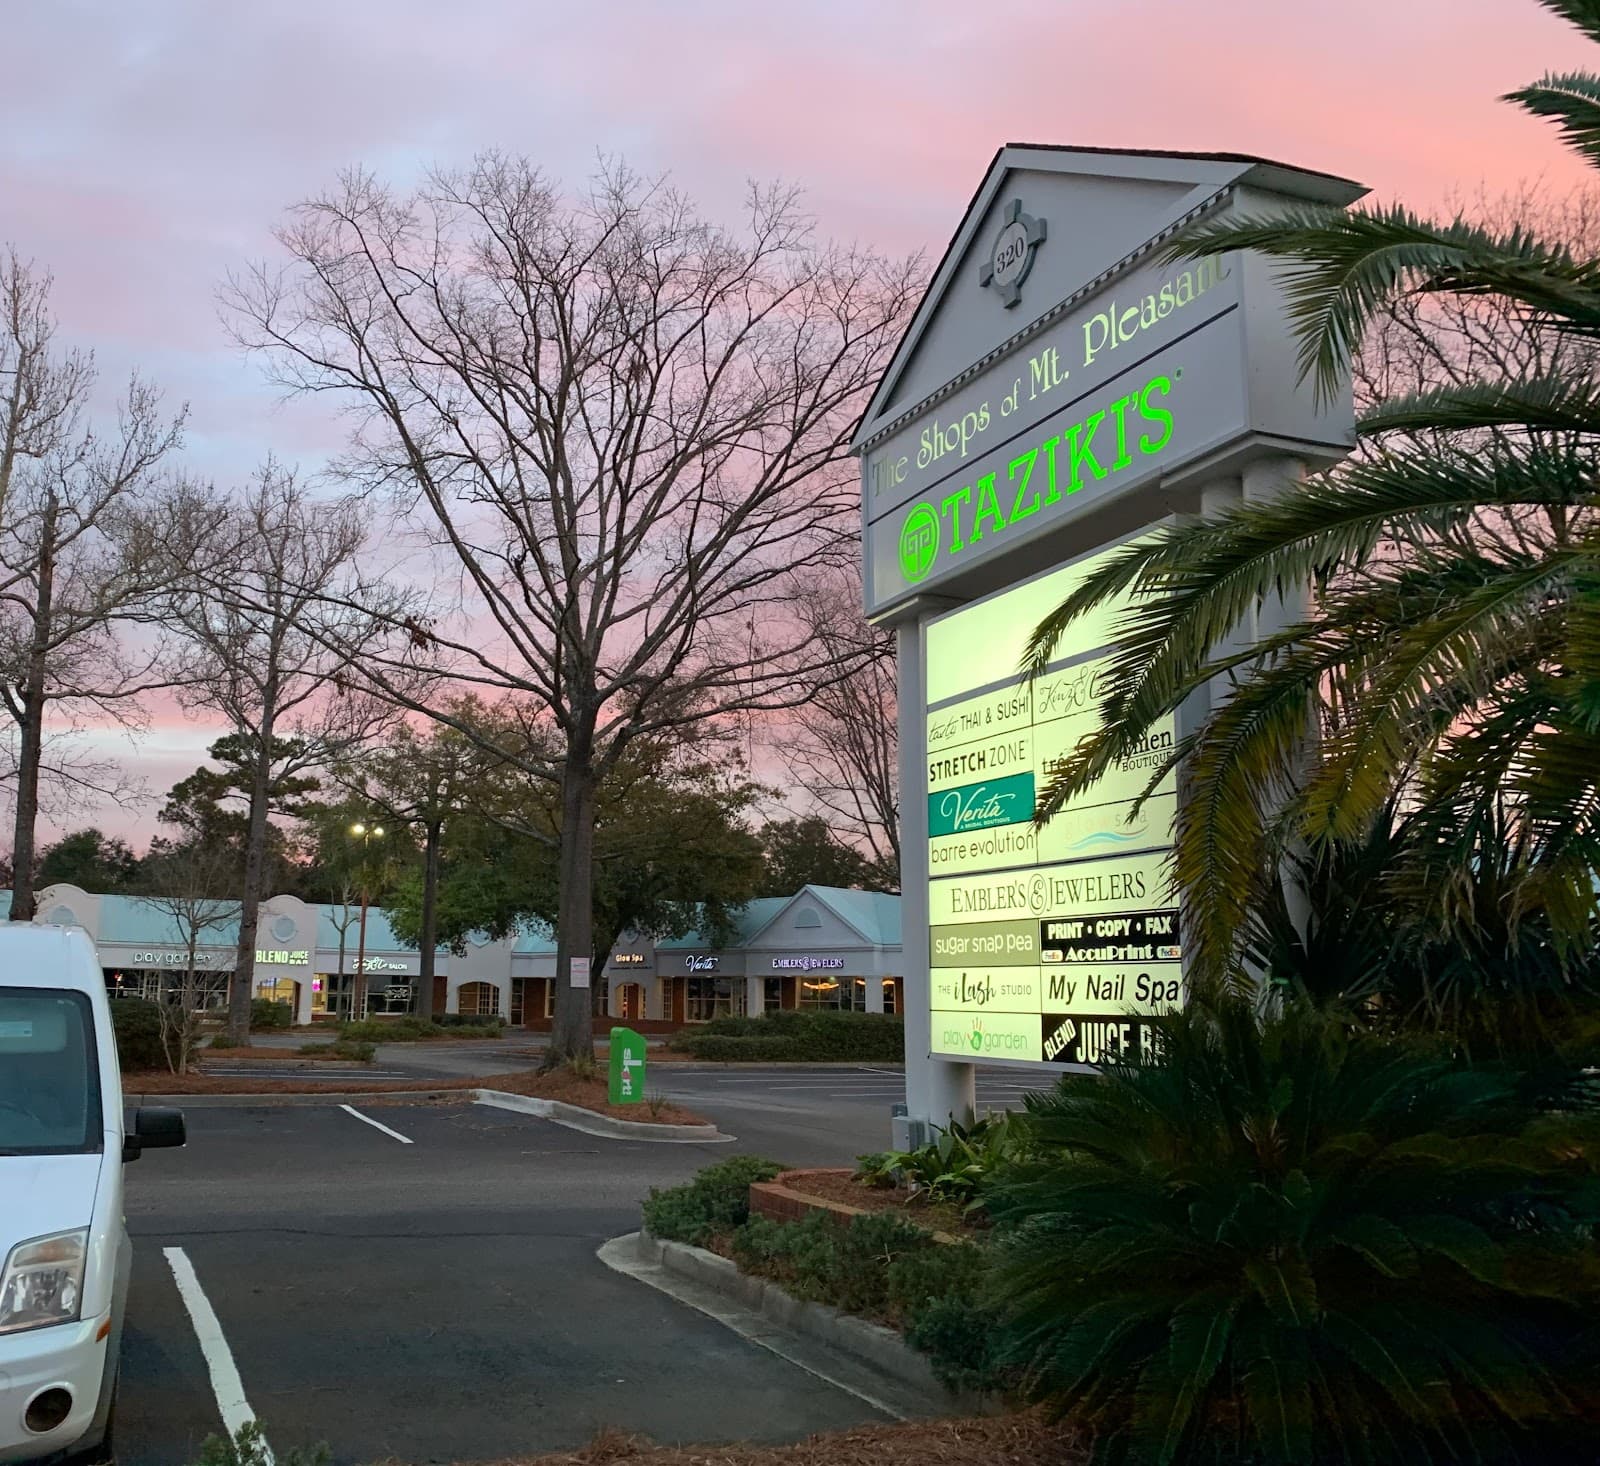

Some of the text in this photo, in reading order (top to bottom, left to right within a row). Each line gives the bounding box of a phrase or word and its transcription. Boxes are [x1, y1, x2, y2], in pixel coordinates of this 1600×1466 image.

[997, 237, 1024, 273] 320
[872, 255, 1232, 497] The Shops of Mt. Pleasant
[942, 375, 1174, 554] TAZIKI'S
[960, 710, 981, 731] THAI
[985, 707, 992, 724] &
[997, 696, 1029, 721] SUSHI
[929, 740, 1026, 782] STRETCH ZONE
[931, 829, 1034, 863] barre evolution
[951, 880, 1026, 913] EMBLER'S
[1046, 871, 1146, 912] JEWELERS
[935, 933, 1033, 955] sugar snap pea
[1047, 916, 1172, 940] PRINT COPY FAX
[135, 952, 163, 963] play
[255, 950, 289, 964] BLEND
[290, 951, 309, 959] JUICE
[615, 953, 644, 963] Glow Spa
[938, 985, 951, 994] THE
[1000, 984, 1032, 995] STUDIO
[1048, 973, 1179, 1006] My Nail Spa
[943, 1030, 1028, 1052] play garden
[1043, 1018, 1076, 1061] BLEND
[1076, 1022, 1130, 1065] JUICE
